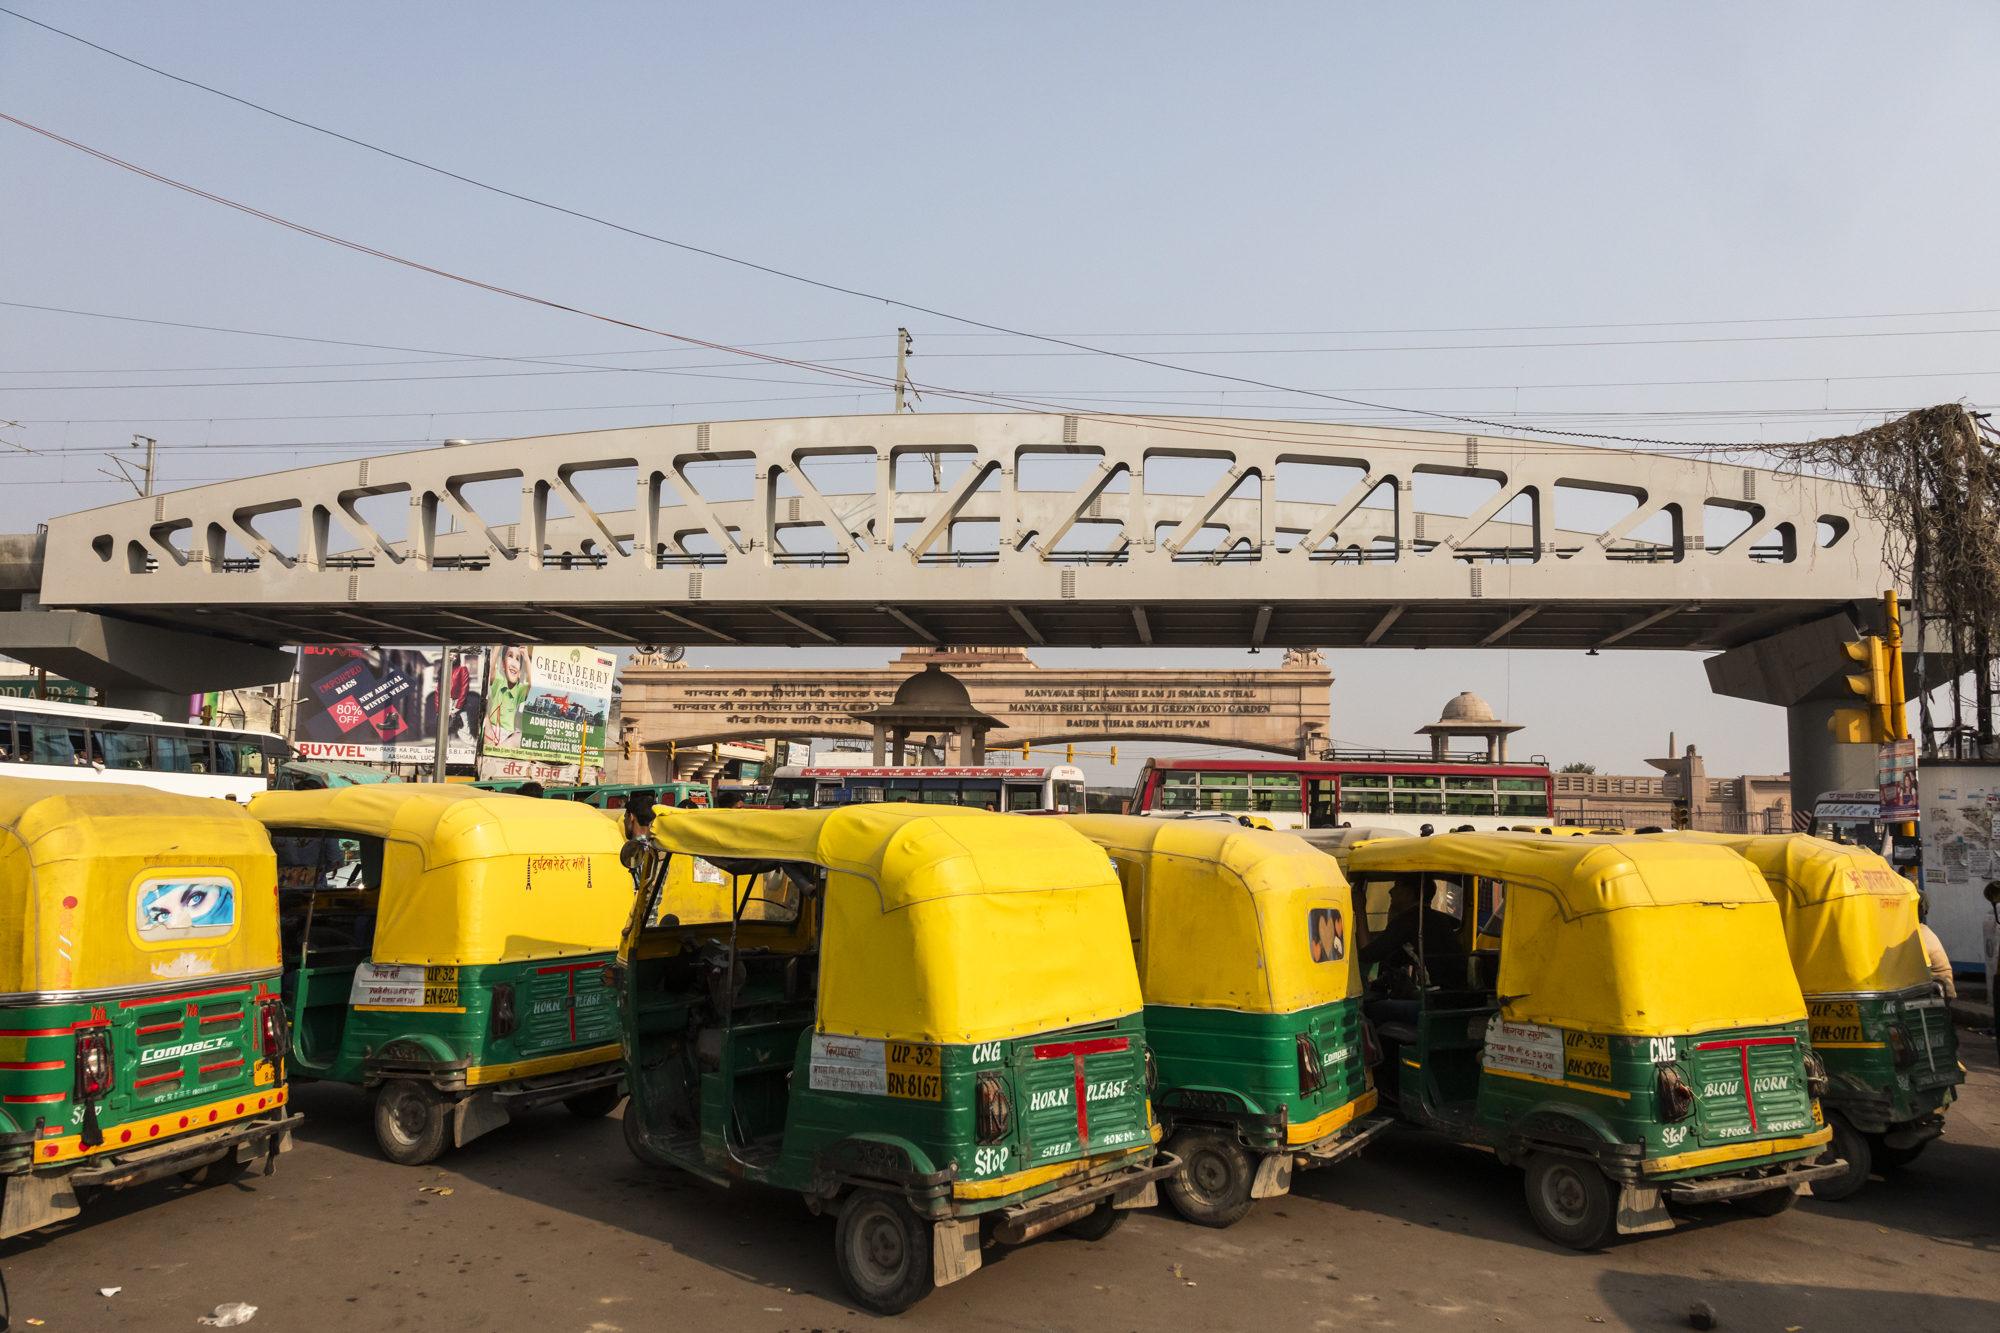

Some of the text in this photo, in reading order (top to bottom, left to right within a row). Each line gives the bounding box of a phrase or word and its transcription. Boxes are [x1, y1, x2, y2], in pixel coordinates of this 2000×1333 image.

[304, 646, 367, 658] BUYVEL
[536, 656, 610, 684] GREENBERRY
[319, 665, 362, 694] IMPORTED
[335, 679, 358, 695] BAGS
[547, 673, 597, 690] WORLD SCHOOL
[359, 675, 403, 704] NEW ARRIVAL
[363, 682, 410, 711] WINTER WEAR
[1025, 689, 1257, 698] MANYAVAR SHRI KANSHI RAM JI SMARAK STHAL
[336, 705, 362, 716] 80%
[1009, 703, 1271, 713] MANYAVAR SHRI KANSHI RAM JI GREEN (ECO) GARDEN
[339, 716, 359, 724] OFF
[530, 716, 574, 731] ADMISSIONS
[1066, 719, 1210, 728] BAUDH VIHAR SHANTI UPVAN
[546, 728, 560, 736] 2017
[521, 738, 531, 747] Call
[300, 744, 365, 757] BUYVEL
[533, 1001, 561, 1014] HORN
[575, 994, 601, 1007] PLEASE
[141, 1037, 227, 1064] Compact
[892, 1045, 934, 1066] UP-32
[972, 1041, 1001, 1064] CNG
[1650, 1036, 1676, 1063] CNG
[1704, 1076, 1788, 1098] BLOW HORN
[1030, 1080, 1128, 1111] HORN PLEASE
[1042, 1143, 1072, 1158] SPEED
